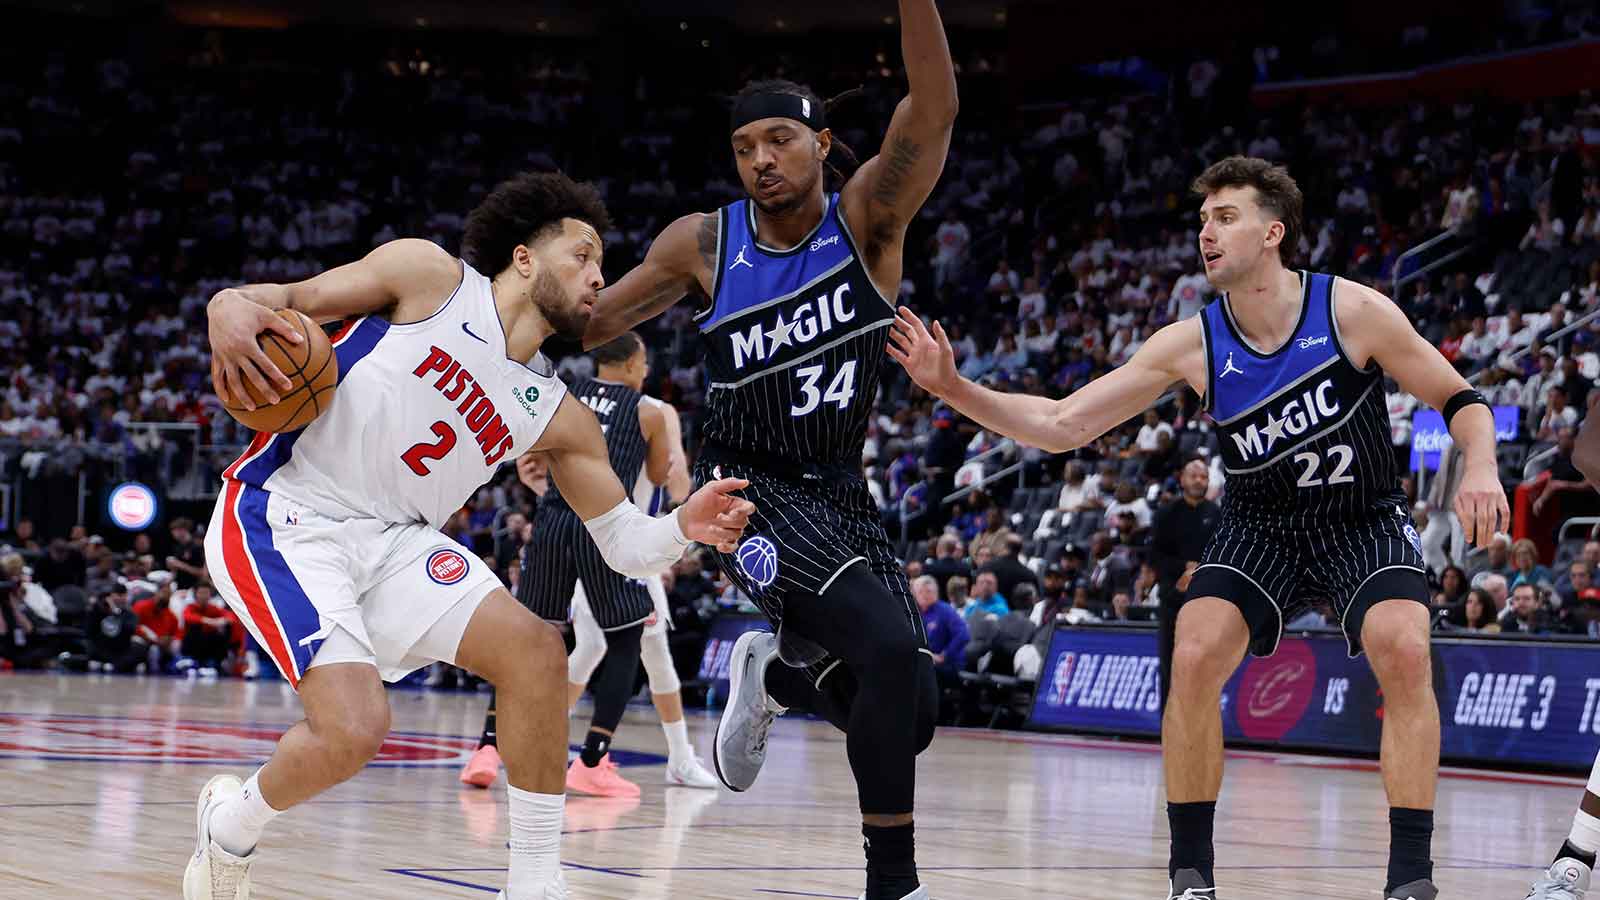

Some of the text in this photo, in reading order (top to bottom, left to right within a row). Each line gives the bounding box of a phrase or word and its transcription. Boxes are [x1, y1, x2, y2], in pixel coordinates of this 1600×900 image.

[809, 234, 839, 251] Disney
[729, 282, 856, 369] MAGIC
[1296, 336, 1329, 349] Disney
[412, 345, 514, 467] PISTONS
[791, 360, 857, 417] 34
[400, 420, 457, 477] 2
[1230, 379, 1340, 462] MAGIC
[1294, 444, 1355, 488] 22
[1323, 677, 1349, 714] VS
[1454, 672, 1535, 728] GAME
[1530, 675, 1556, 730] 3
